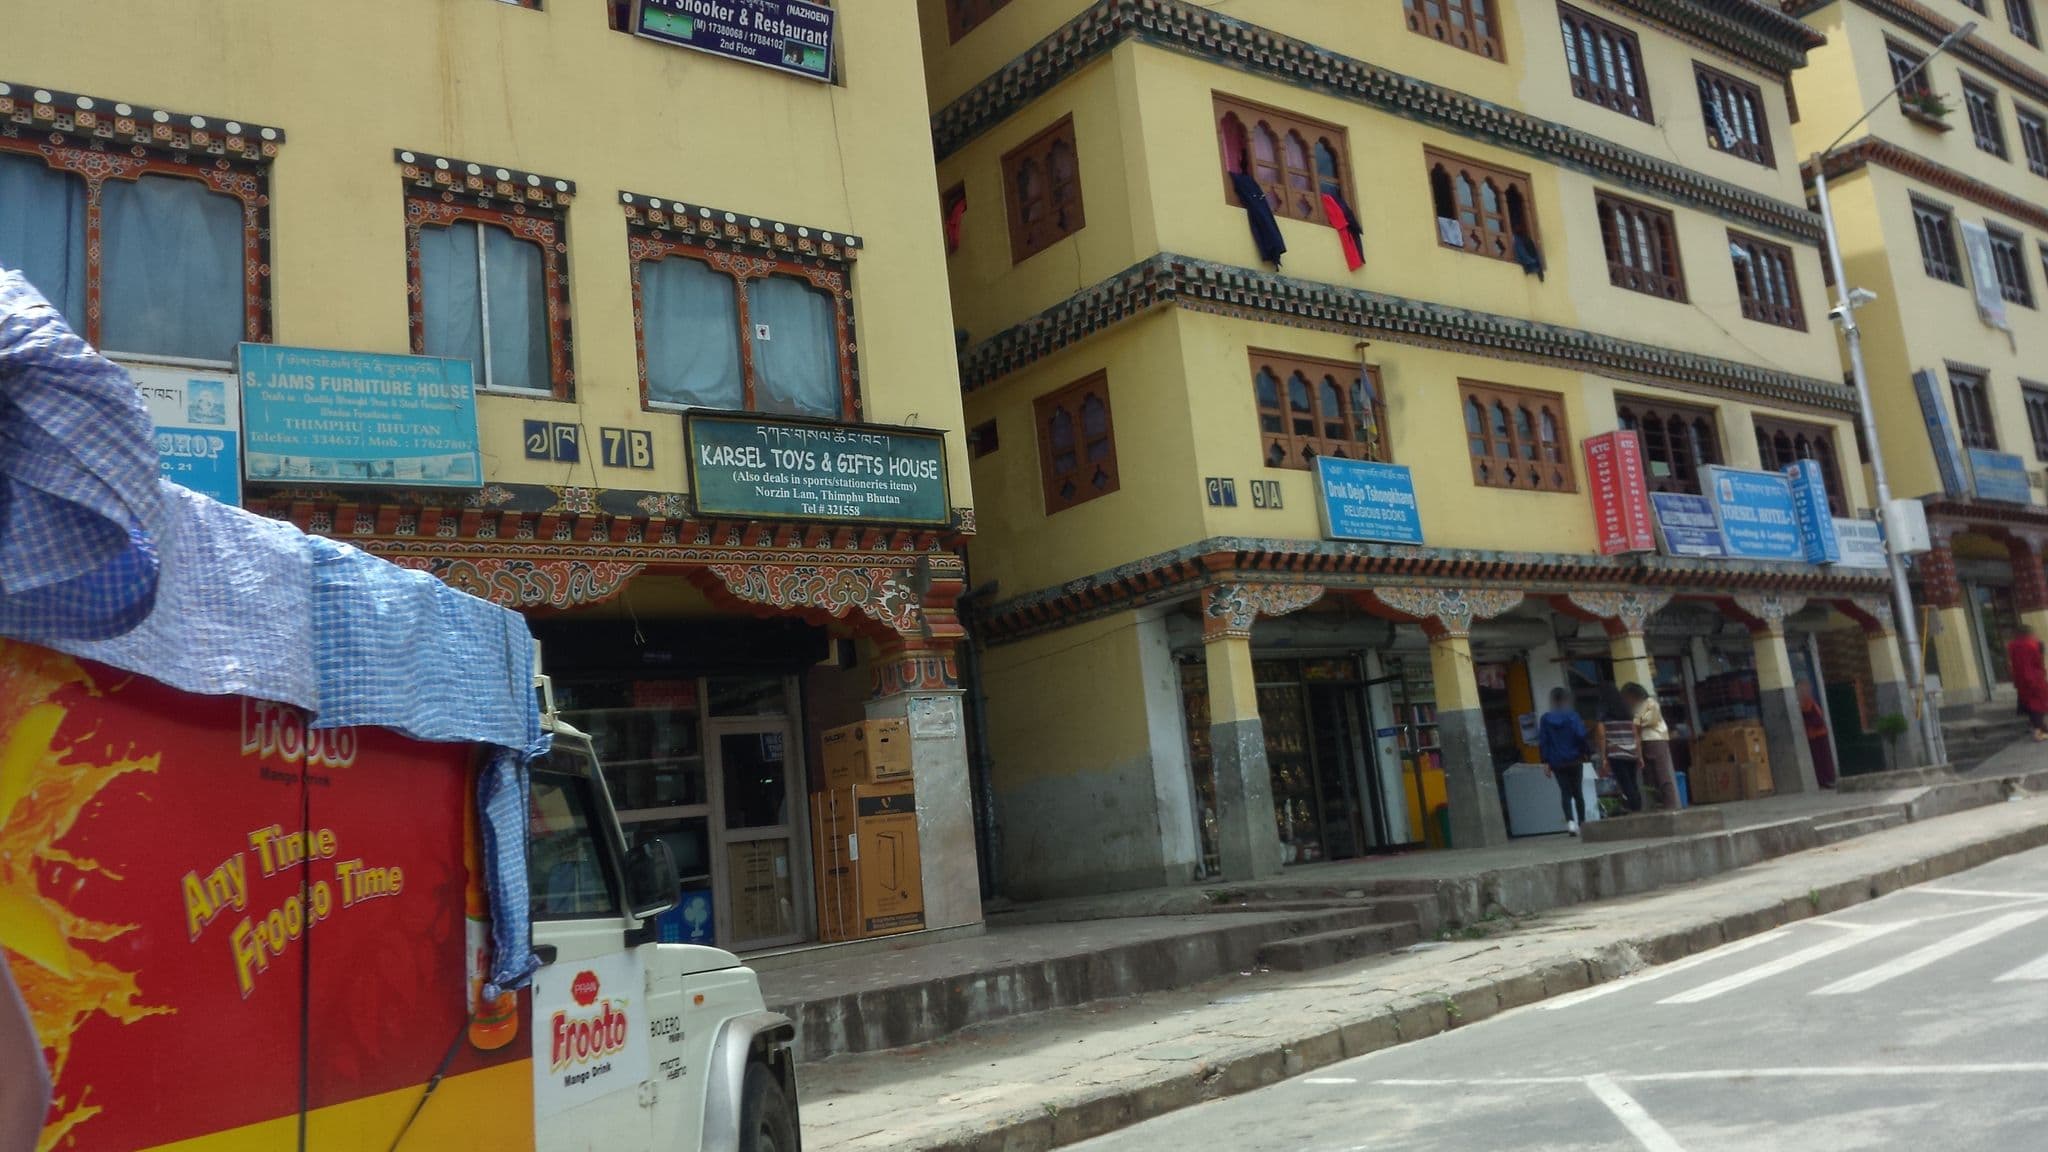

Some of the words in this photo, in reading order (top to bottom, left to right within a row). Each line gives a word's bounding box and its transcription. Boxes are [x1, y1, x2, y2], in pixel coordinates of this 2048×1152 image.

[739, 8, 749, 25] &
[754, 12, 828, 46] Restaurant
[787, 4, 829, 25] (NAZHOEN)
[693, 18, 706, 32] (M)
[750, 33, 784, 50] 17884102
[720, 38, 735, 51] 2nd
[736, 41, 757, 56] Floor
[246, 372, 262, 388] S.
[268, 374, 315, 391] JAMS
[320, 376, 413, 397] FURNITURE
[418, 382, 470, 400] HOUSE
[284, 418, 364, 433] THIMPHU
[377, 423, 441, 435] BHUTAN
[159, 433, 224, 458] SHOP
[603, 429, 650, 469] 7B
[178, 463, 192, 471] 21
[700, 444, 765, 470] KARSEL
[774, 448, 815, 472] TOYS
[821, 452, 832, 473] &
[837, 453, 884, 476] GIFTS
[889, 457, 937, 480] HOUSE
[732, 470, 760, 484] (Also
[763, 472, 788, 485] deals
[790, 474, 801, 486] in
[803, 477, 894, 492] sports/stationeries
[896, 479, 918, 494] items)
[1253, 481, 1282, 508] 9A
[755, 486, 791, 499] Norzin
[793, 487, 820, 502] Lam,
[822, 489, 865, 506] Thimphu
[866, 492, 901, 505] Bhutan
[801, 502, 818, 514] Tel
[818, 504, 826, 515] #
[827, 505, 861, 516] 321558
[1382, 508, 1407, 522] BOOKS
[303, 774, 332, 787] rink
[182, 852, 246, 943] Any
[248, 823, 338, 879] Time
[334, 858, 404, 909] Time
[551, 999, 629, 1075] Frooto
[650, 1016, 681, 1038] BOLERO
[564, 1069, 591, 1088] Mango
[591, 1062, 612, 1077] Drink
